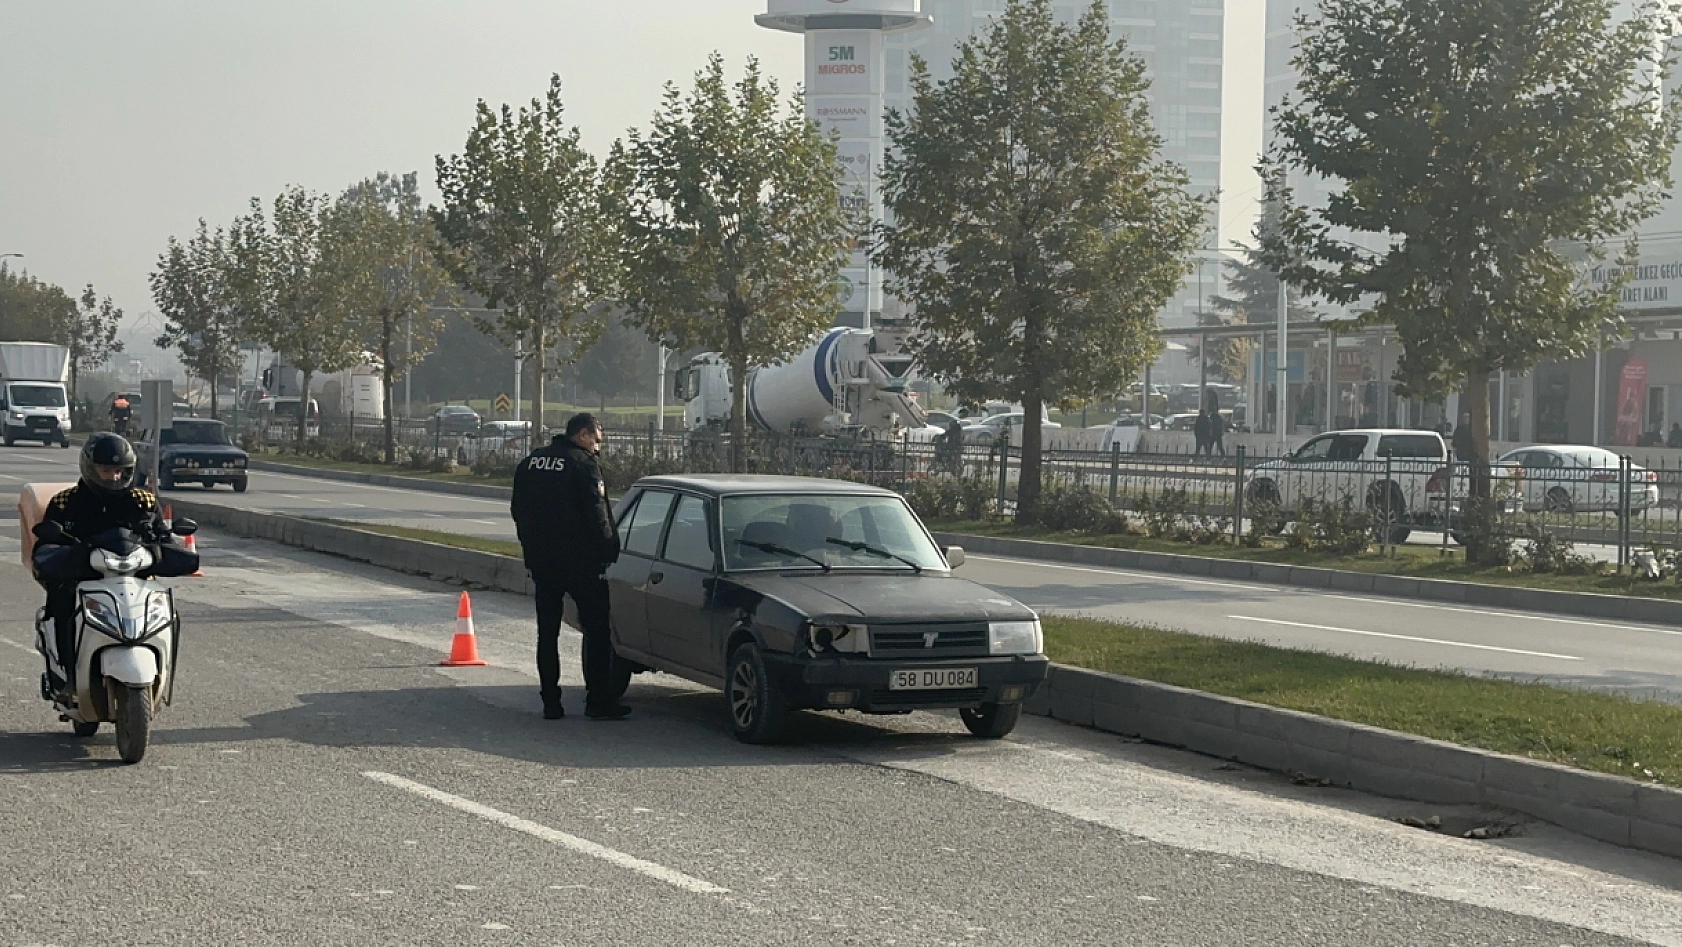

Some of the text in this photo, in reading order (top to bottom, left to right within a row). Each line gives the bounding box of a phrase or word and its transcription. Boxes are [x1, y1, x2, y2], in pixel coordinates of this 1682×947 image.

[829, 46, 854, 60] 5M
[1643, 287, 1668, 302] ALANI
[898, 670, 973, 687] 58 DU 084
